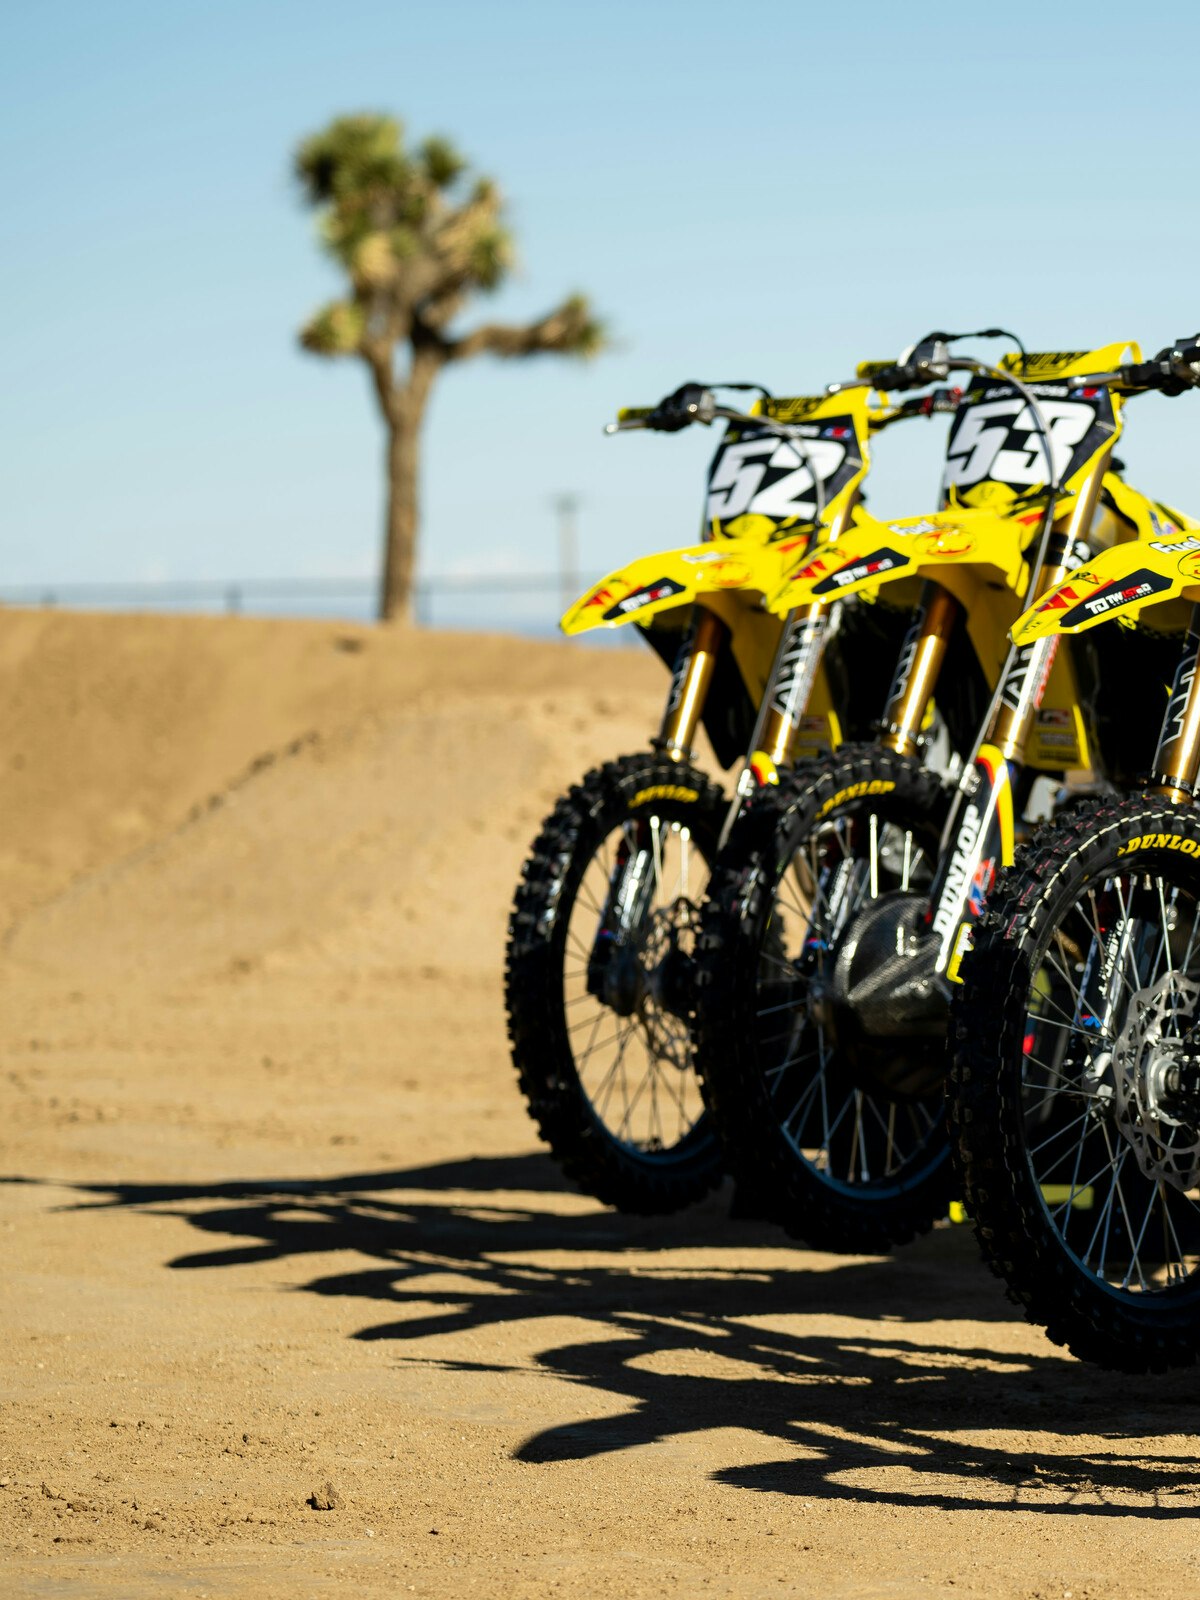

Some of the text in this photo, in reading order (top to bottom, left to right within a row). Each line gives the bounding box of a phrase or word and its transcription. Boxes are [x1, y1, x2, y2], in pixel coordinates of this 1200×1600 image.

[706, 437, 846, 521] 52
[948, 398, 1096, 492] 53
[932, 803, 982, 936] DUNLOP
